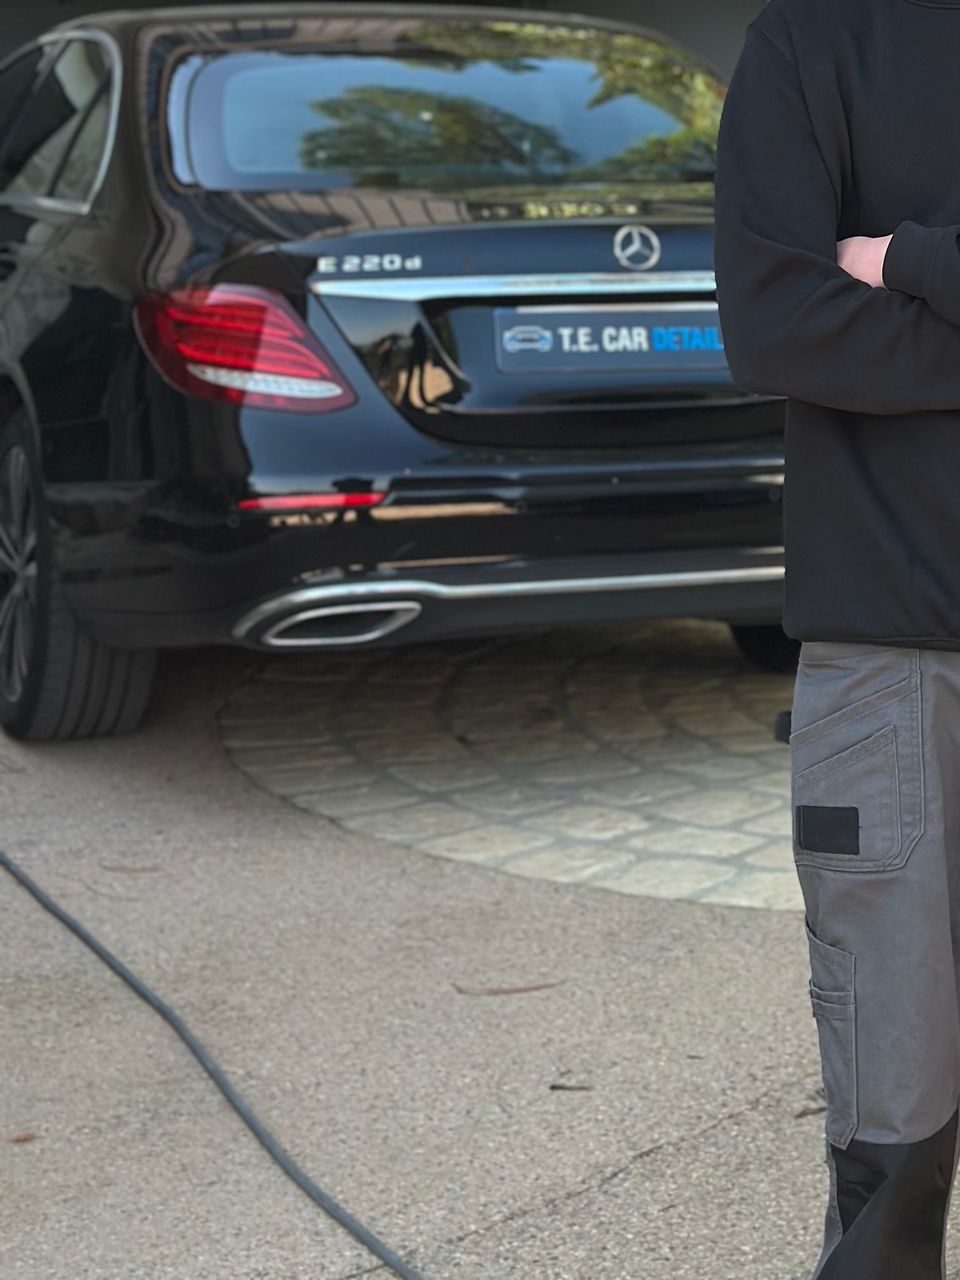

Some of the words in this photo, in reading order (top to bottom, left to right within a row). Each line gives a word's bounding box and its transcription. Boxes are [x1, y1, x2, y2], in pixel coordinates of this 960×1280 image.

[317, 256, 336, 273] E
[342, 253, 422, 272] 220d
[558, 326, 599, 352] T.E.
[602, 326, 649, 352] CAR
[652, 326, 725, 352] DETAIL
